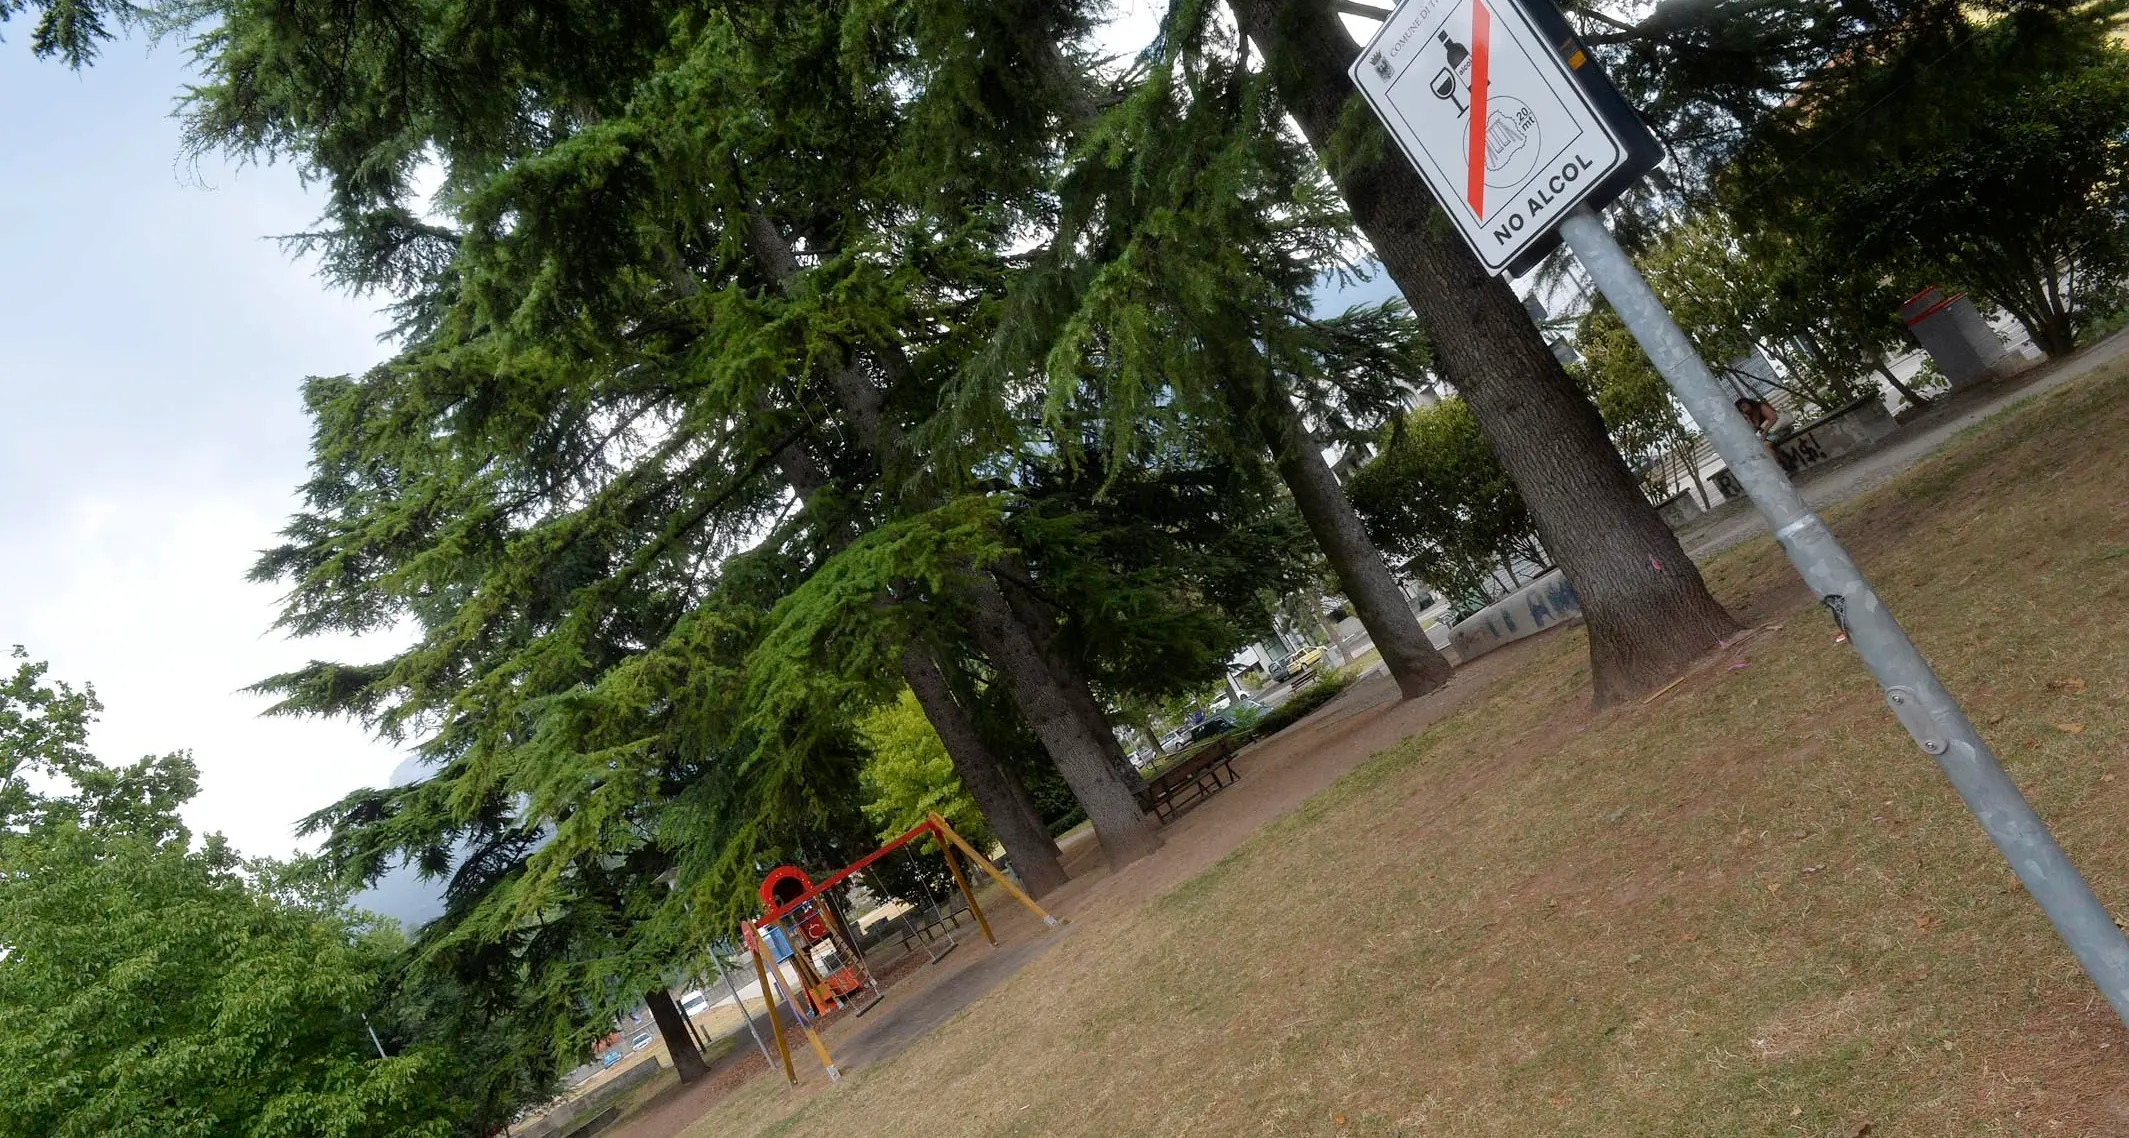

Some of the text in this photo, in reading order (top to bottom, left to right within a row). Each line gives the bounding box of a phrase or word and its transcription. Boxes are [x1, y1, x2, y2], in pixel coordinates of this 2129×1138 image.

[1390, 17, 1422, 57] COMUNE
[1420, 5, 1431, 20] DI
[1516, 107, 1528, 122] 20
[1521, 116, 1536, 131] mt
[1493, 154, 1593, 246] NO ALCOL
